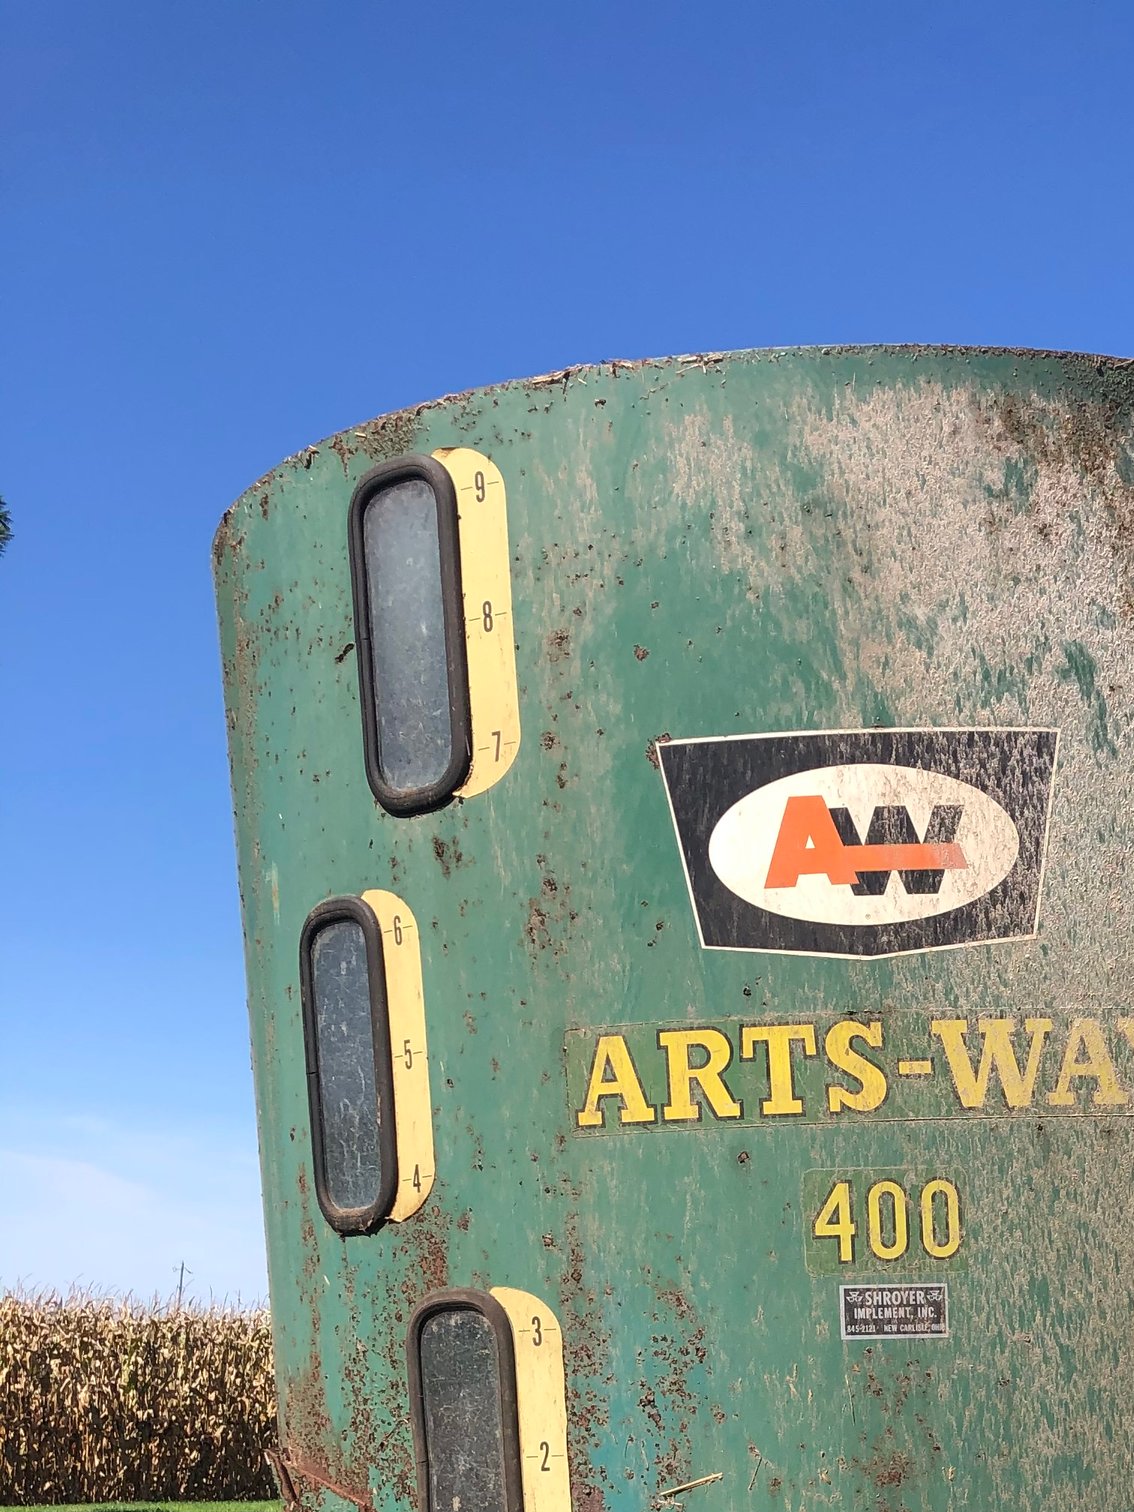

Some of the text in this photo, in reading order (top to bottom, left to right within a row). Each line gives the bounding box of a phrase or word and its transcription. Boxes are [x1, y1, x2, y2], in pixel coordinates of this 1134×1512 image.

[474, 470, 485, 503] 9
[482, 600, 493, 633] 8
[491, 731, 501, 762] 7
[393, 915, 403, 945] 6
[403, 1039, 413, 1070] 5
[412, 1164, 422, 1193] 4
[812, 1177, 964, 1263] 400
[865, 1290, 925, 1305] SHROYER
[917, 1306, 938, 1318] INC.
[531, 1316, 541, 1346] 3
[883, 1324, 897, 1332] NEW
[540, 1441, 550, 1471] 2
